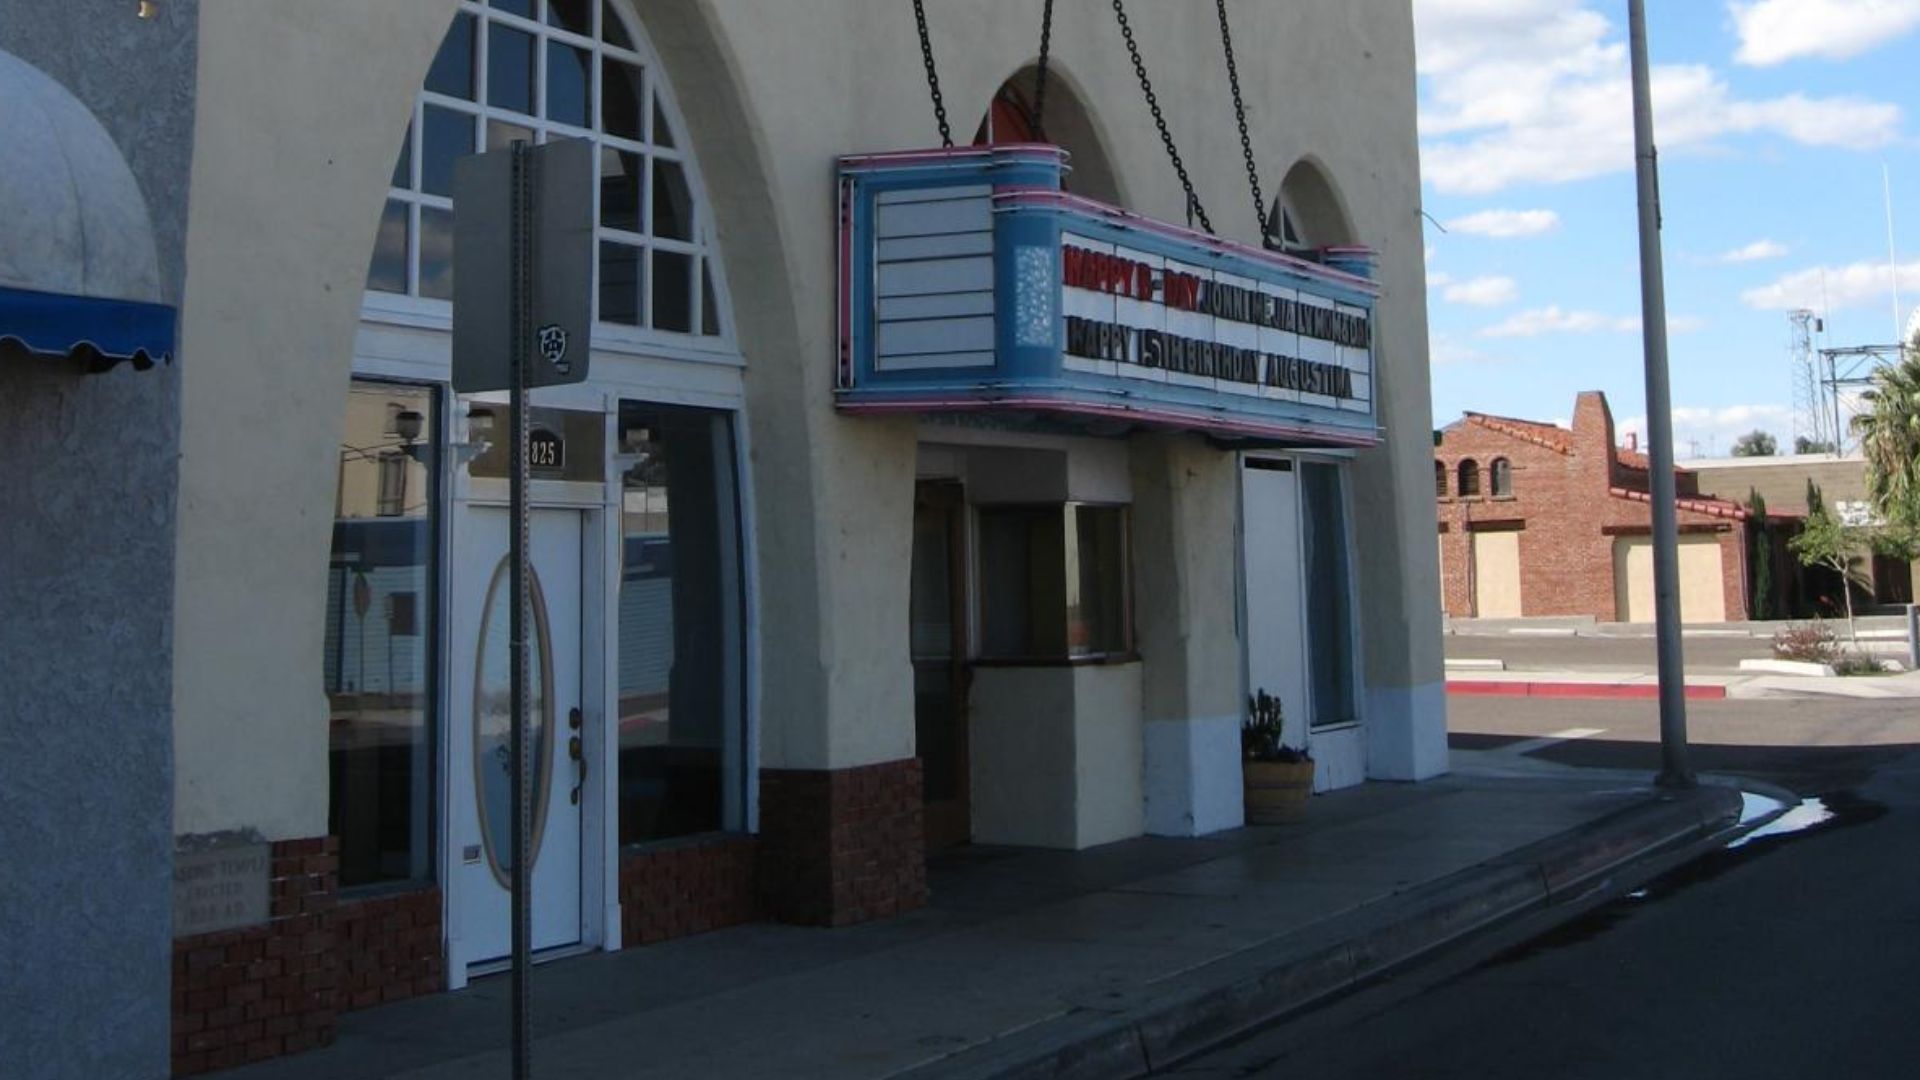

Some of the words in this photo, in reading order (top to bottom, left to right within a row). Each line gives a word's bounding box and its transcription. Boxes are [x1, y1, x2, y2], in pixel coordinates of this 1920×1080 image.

[1063, 244, 1135, 298] HAPPY
[1067, 316, 1132, 362] HAPPY
[532, 441, 555, 465] 825
